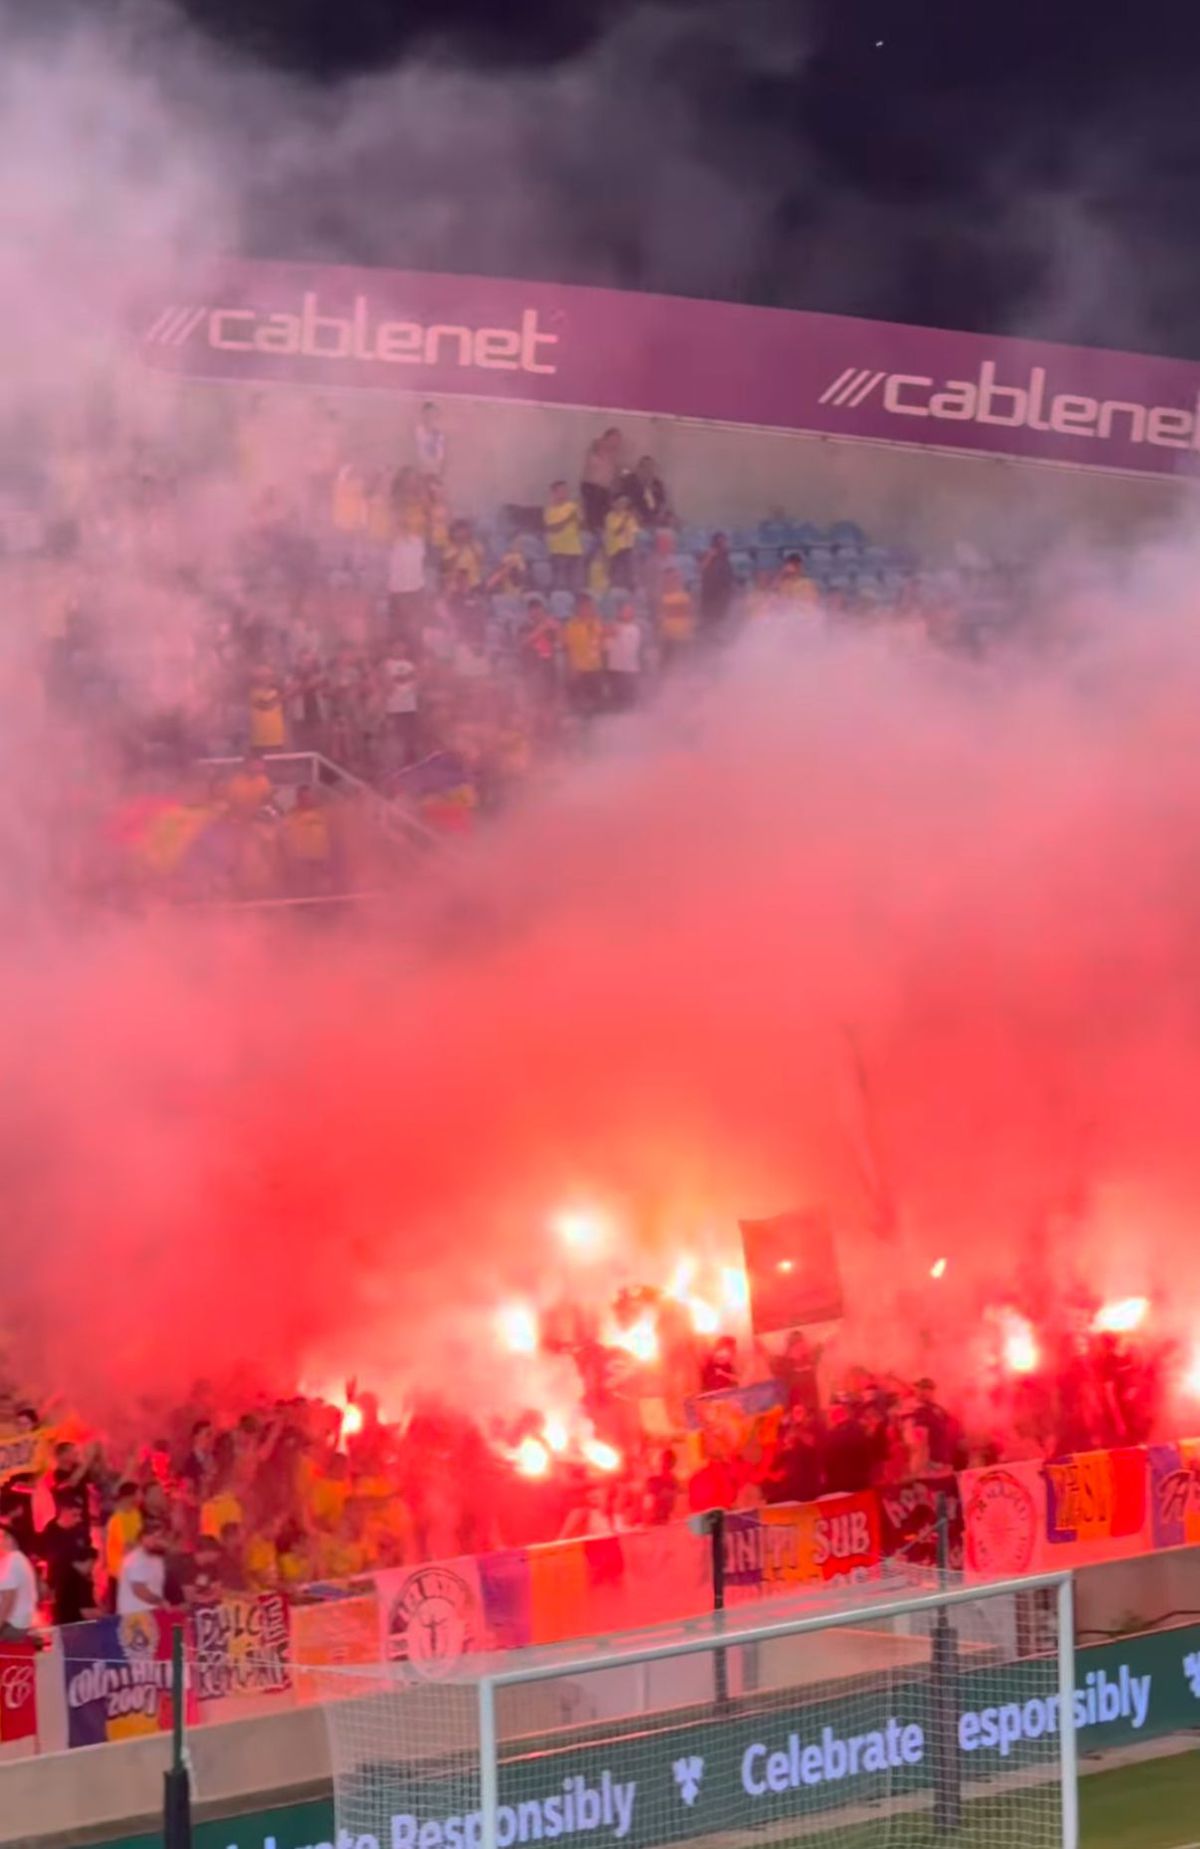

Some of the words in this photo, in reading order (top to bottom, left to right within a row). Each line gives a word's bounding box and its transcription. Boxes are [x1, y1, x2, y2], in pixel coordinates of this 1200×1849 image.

[208, 291, 559, 375] cablenet
[813, 1511, 870, 1565] SUB
[741, 1716, 924, 1796] Celebrate
[957, 1664, 1151, 1757] esponsibly
